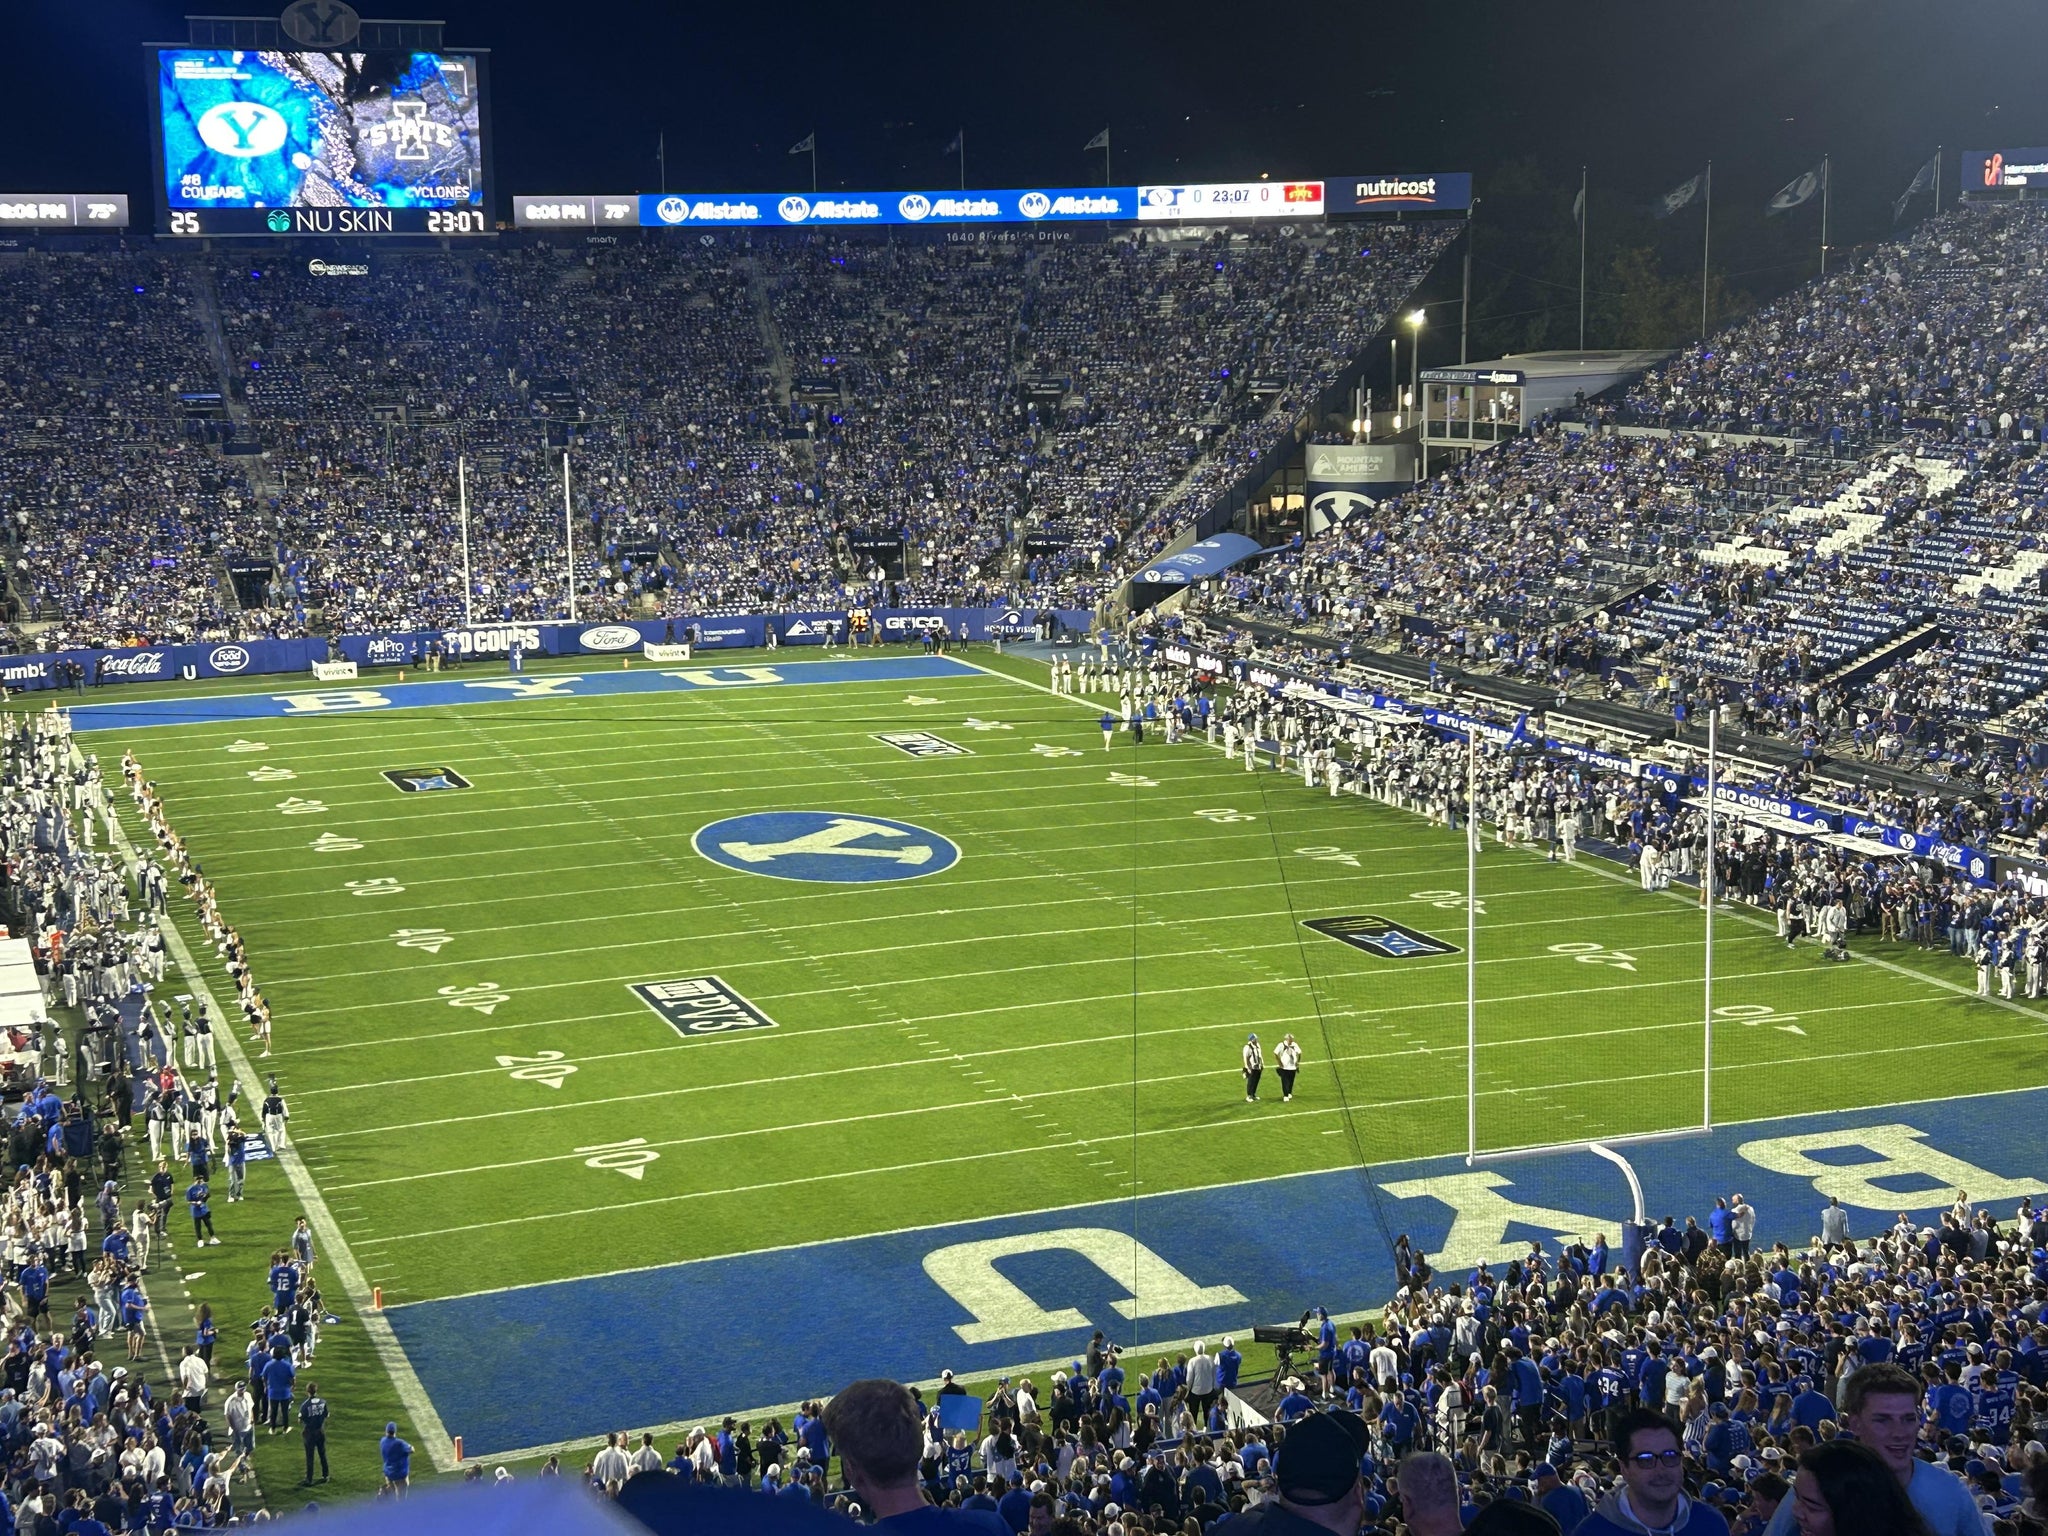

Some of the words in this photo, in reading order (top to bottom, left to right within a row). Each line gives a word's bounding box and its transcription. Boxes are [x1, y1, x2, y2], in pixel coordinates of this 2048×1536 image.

[370, 119, 452, 147] STATE
[181, 186, 246, 199] COUGARS
[404, 185, 470, 198] CYCLONES
[1212, 189, 1250, 202] 23:07
[1356, 177, 1436, 196] nutricost
[171, 211, 200, 233] 25
[296, 210, 333, 232] NU
[338, 209, 393, 232] SKIN
[428, 211, 484, 232] 23:07
[1336, 456, 1383, 464] MOUNTAIN
[1339, 463, 1379, 472] AMERICA
[593, 630, 628, 645] Ford
[1715, 787, 1738, 801] GO
[1738, 793, 1792, 817] COUGS
[343, 877, 406, 896] 50
[437, 981, 511, 1008] 30
[495, 1050, 579, 1081] 20
[573, 1137, 661, 1170] 10
